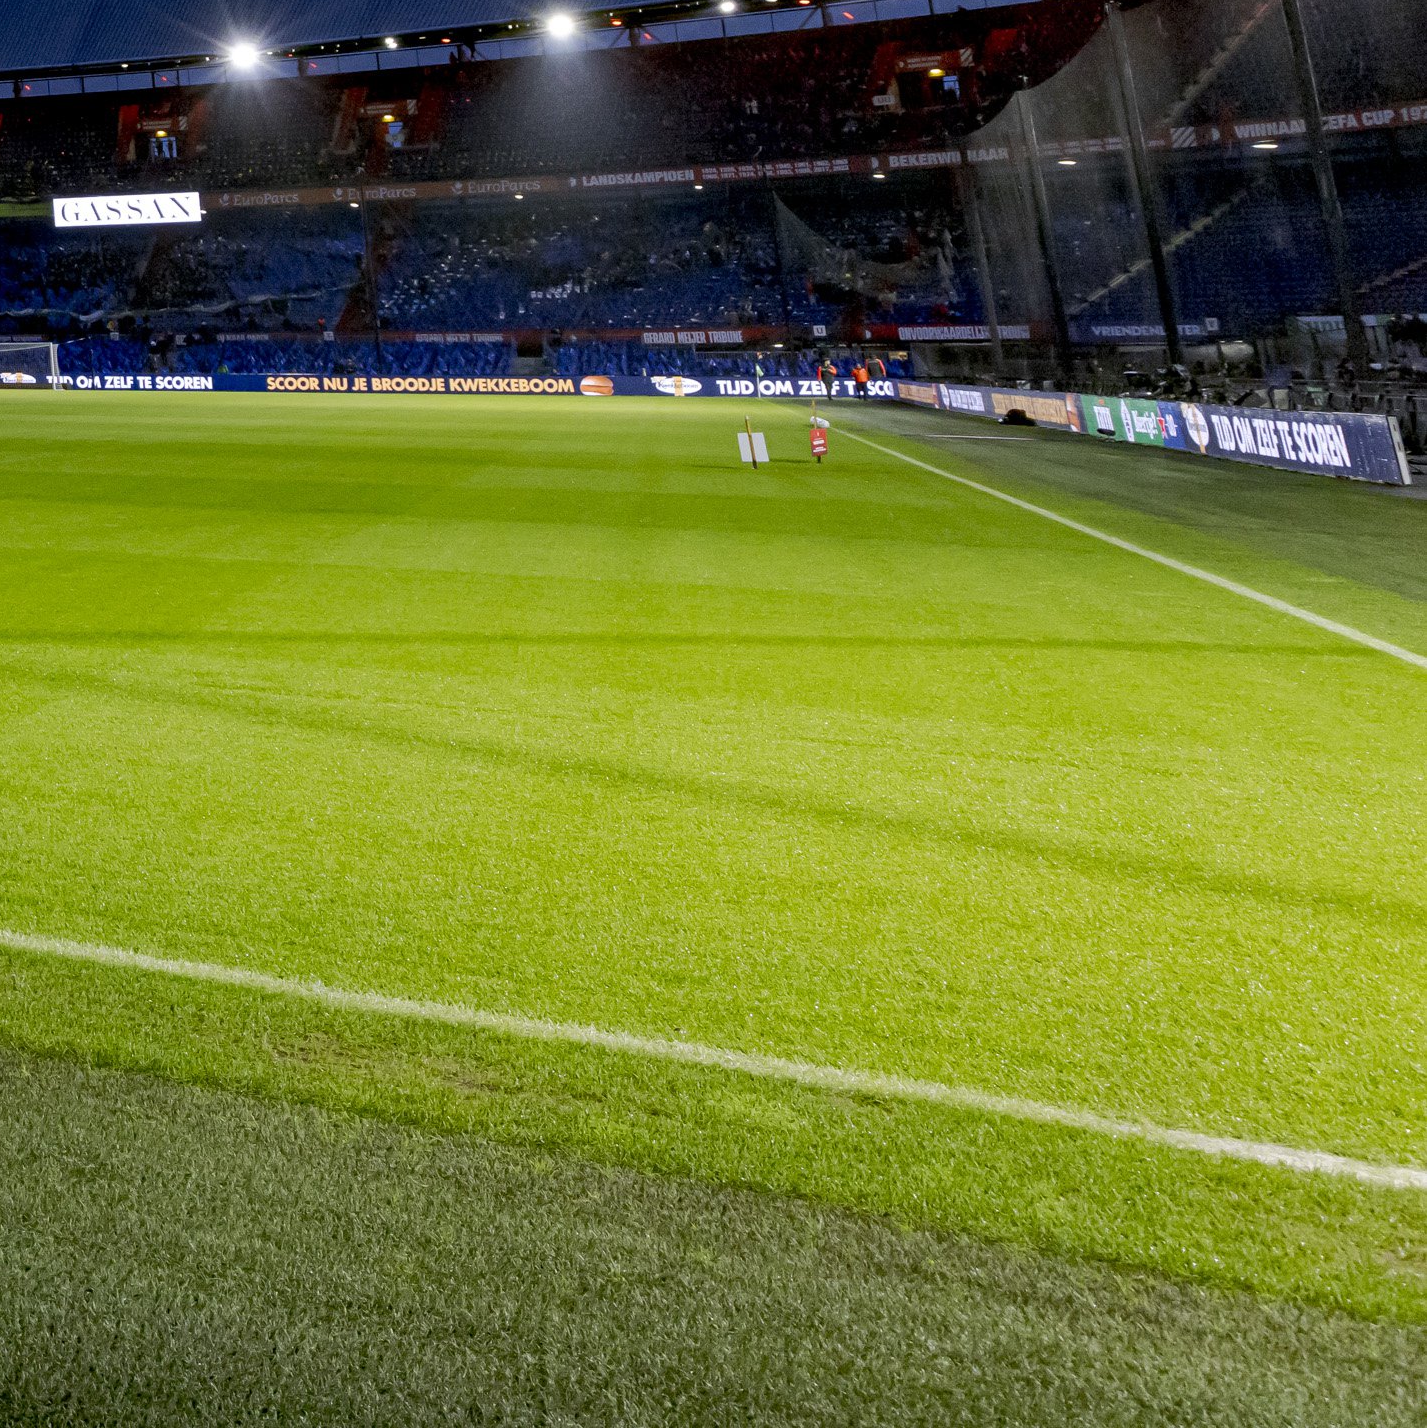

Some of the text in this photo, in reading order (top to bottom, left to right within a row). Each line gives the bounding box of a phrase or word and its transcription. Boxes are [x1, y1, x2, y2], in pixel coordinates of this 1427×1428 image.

[1361, 109, 1395, 126] CUP
[582, 169, 695, 187] LANDSKAMPIOEN
[467, 179, 541, 194] EuroParcs
[233, 193, 299, 207] EuroParcs
[61, 196, 191, 223] GASSAN
[643, 331, 676, 344] GERARD
[708, 330, 744, 344] TRIBUNE
[104, 376, 134, 389] ZELF
[136, 376, 153, 389] TE
[155, 376, 213, 390] SCOREN
[266, 377, 575, 393] SCOOR NU JE BROODJE KWEKKEBOOM
[715, 380, 755, 395] TIJD
[758, 380, 795, 395] OM
[1211, 414, 1236, 451] TIJD
[1232, 416, 1257, 454] OM
[1252, 418, 1280, 458] ZELF
[1275, 420, 1298, 460] TE
[1292, 421, 1352, 468] SCOREN
